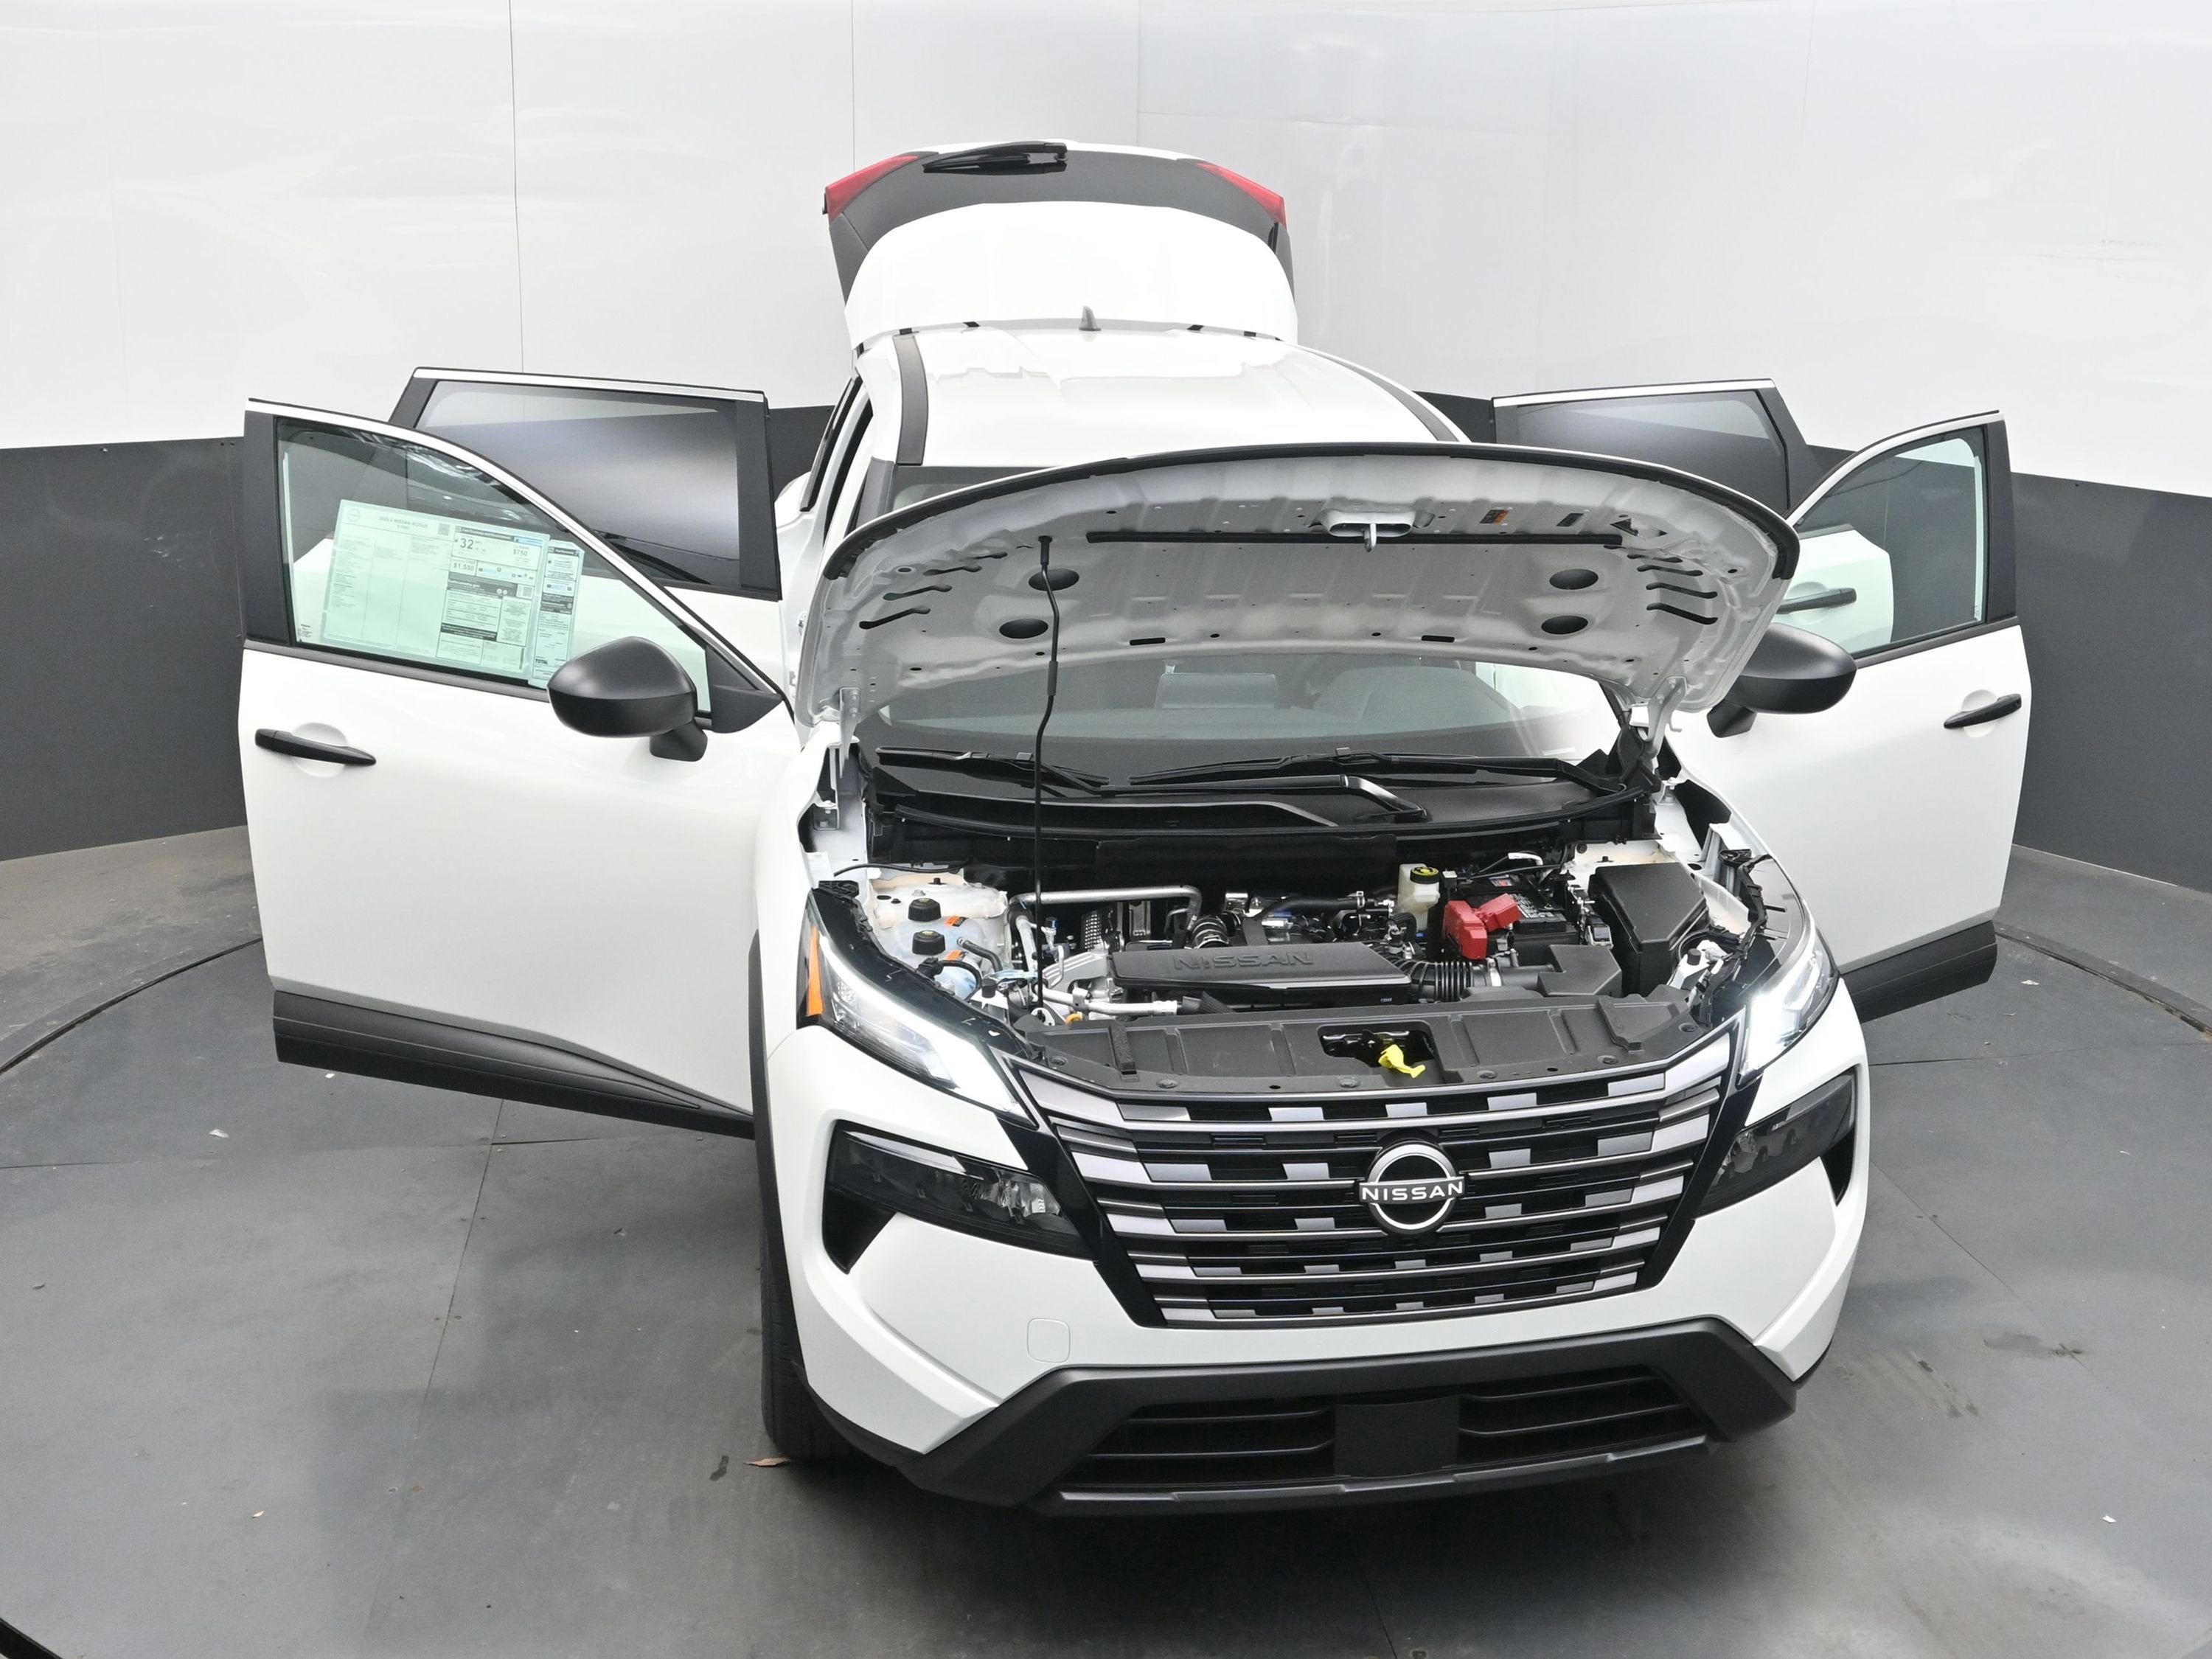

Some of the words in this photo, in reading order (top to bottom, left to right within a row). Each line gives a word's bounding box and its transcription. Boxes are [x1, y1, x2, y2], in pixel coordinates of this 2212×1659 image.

[459, 538, 473, 549] 32
[1172, 951, 1315, 970] NISSAN
[1361, 1180, 1464, 1201] NISSAN
